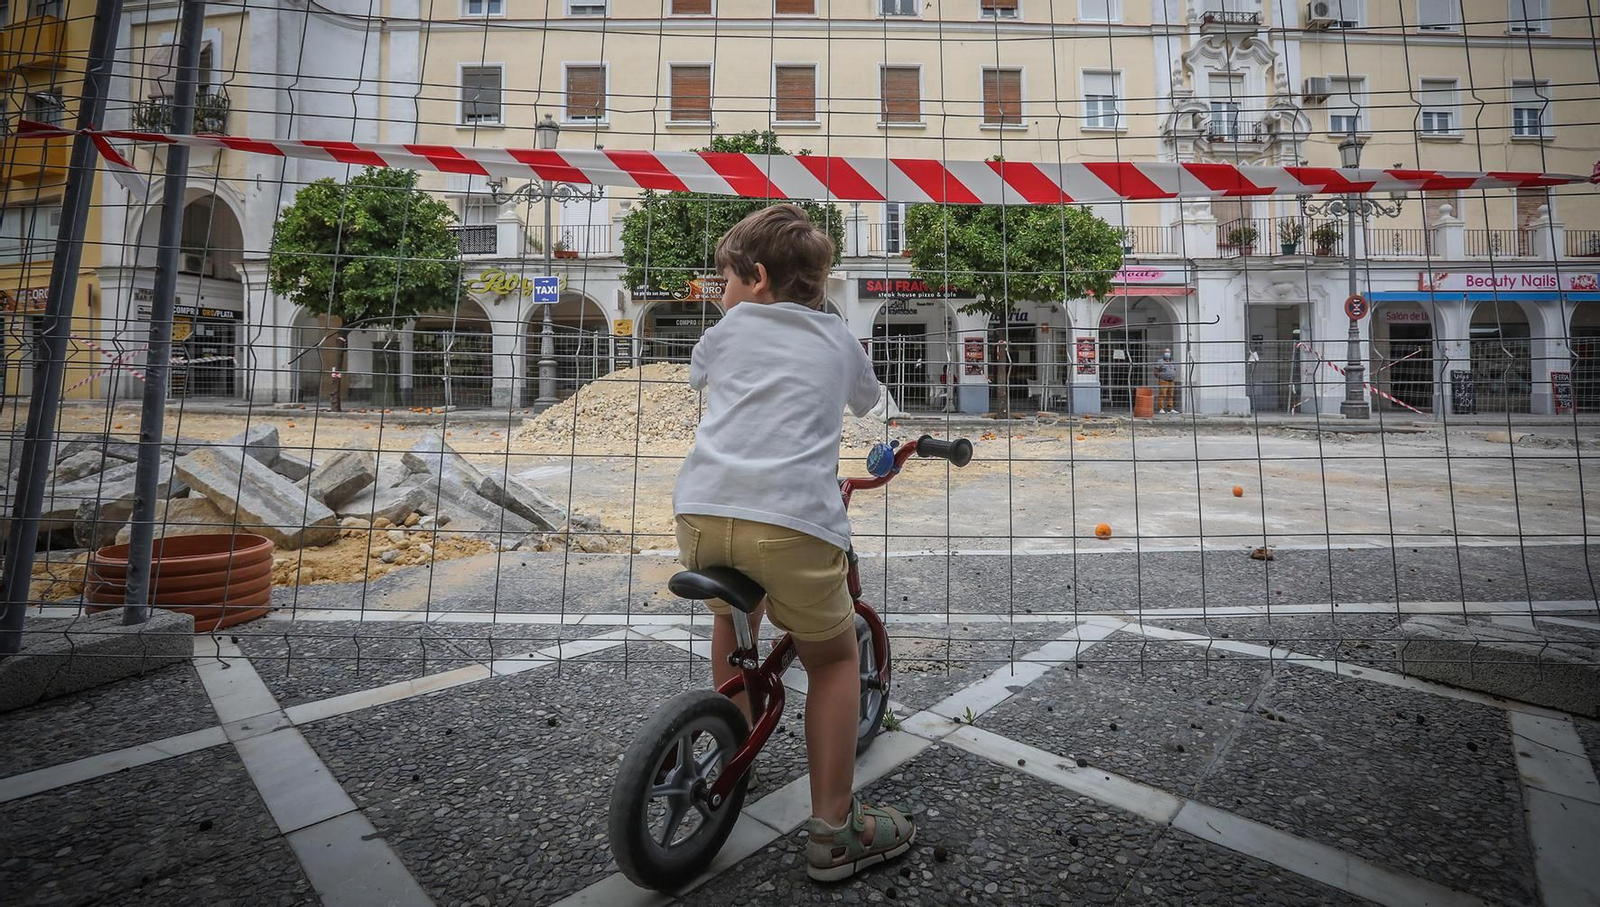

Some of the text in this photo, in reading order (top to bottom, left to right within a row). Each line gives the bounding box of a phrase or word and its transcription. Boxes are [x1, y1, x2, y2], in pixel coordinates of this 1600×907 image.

[866, 280, 892, 292] SAN
[1466, 274, 1557, 290] Beauty Nails
[535, 286, 557, 295] TAXI
[701, 286, 722, 294] ORO
[918, 291, 935, 299] pizza
[1386, 310, 1408, 321] Salón
[1410, 310, 1420, 321] de
